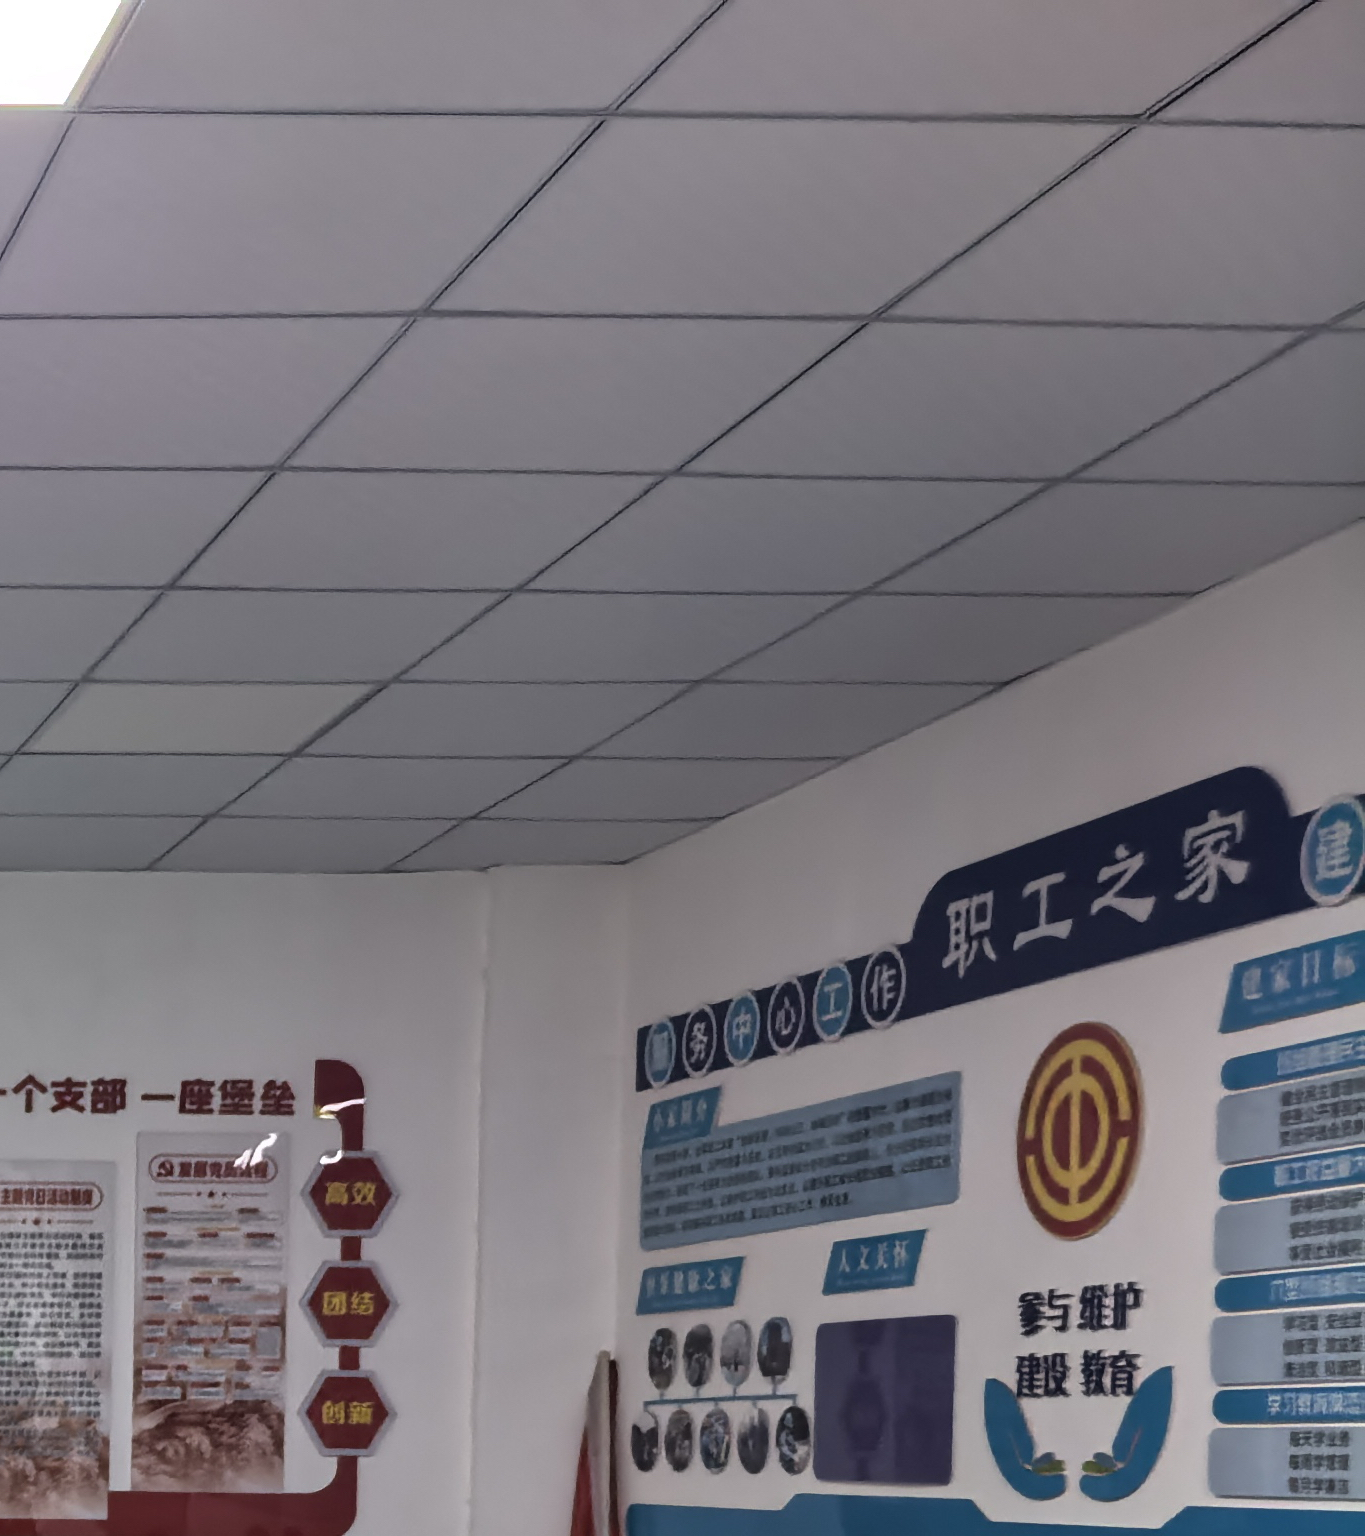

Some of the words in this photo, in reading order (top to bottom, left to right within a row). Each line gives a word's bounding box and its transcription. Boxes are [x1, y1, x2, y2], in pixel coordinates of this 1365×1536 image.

[942, 809, 1251, 979] 职工之家
[141, 1078, 297, 1117] 一座堡垒
[325, 1181, 376, 1206] 高效
[322, 1291, 375, 1316] 团结
[1079, 1350, 1141, 1396] 教育
[322, 1401, 374, 1425] 创新
